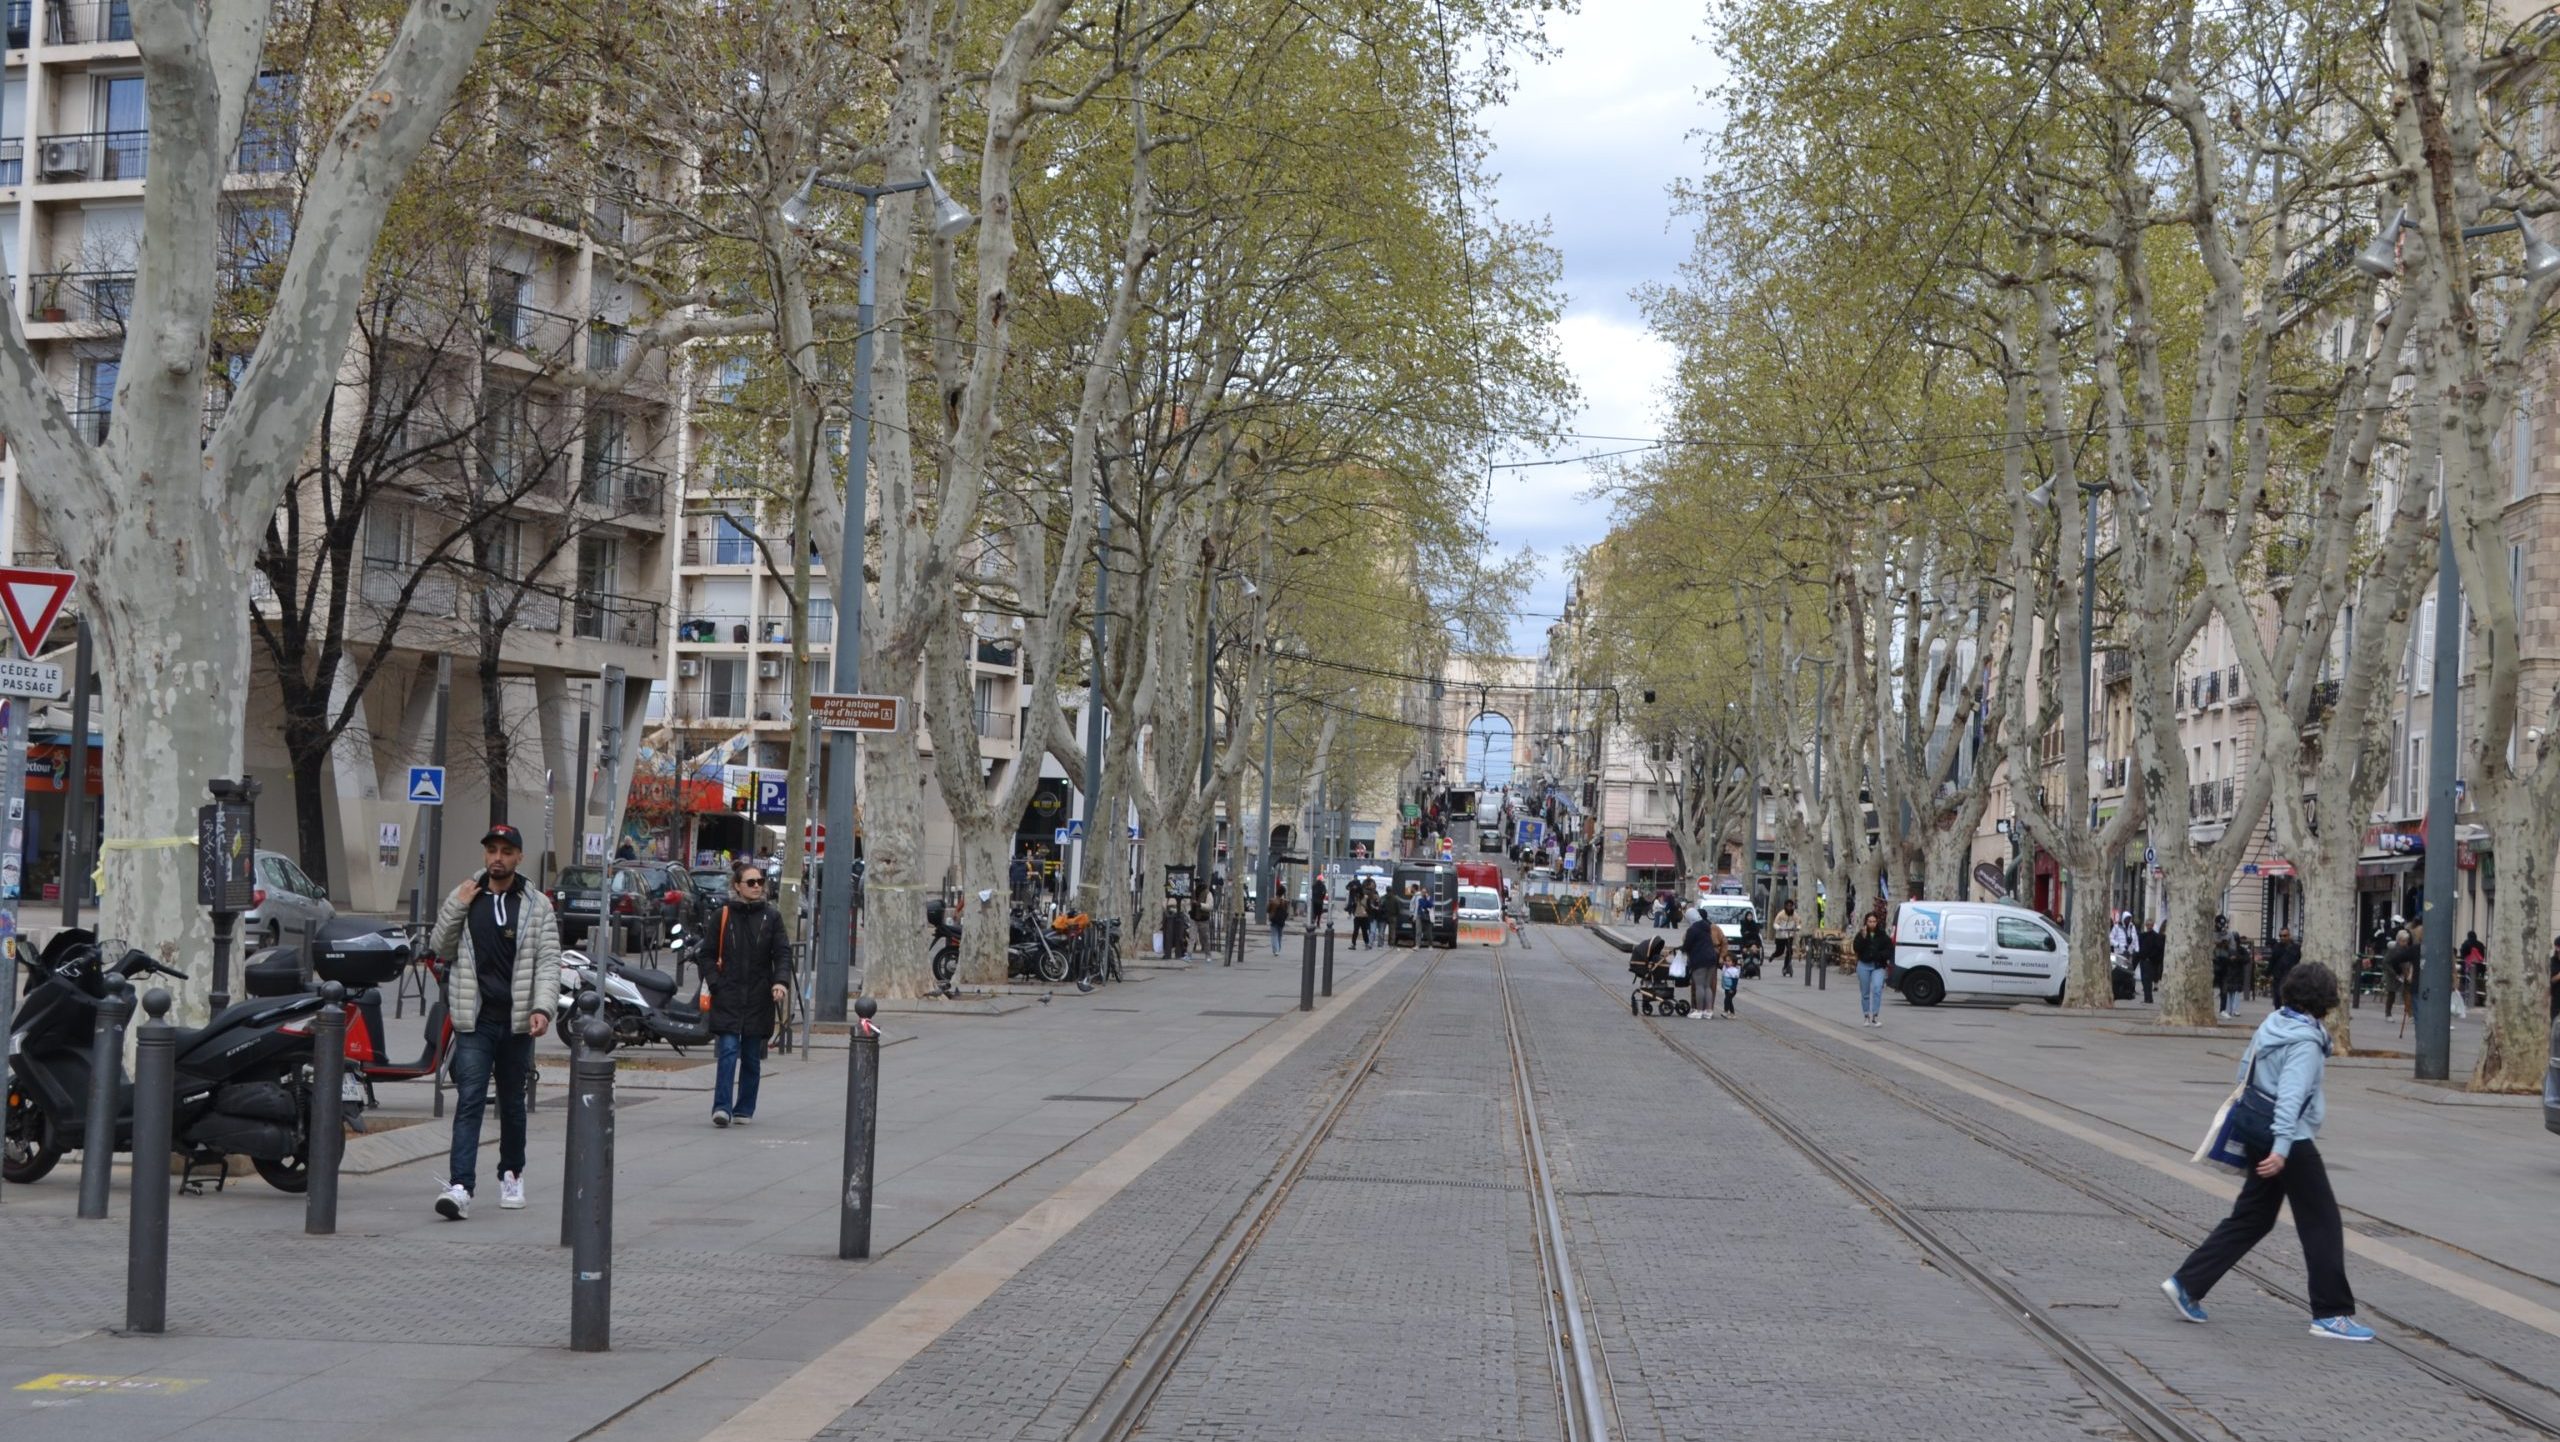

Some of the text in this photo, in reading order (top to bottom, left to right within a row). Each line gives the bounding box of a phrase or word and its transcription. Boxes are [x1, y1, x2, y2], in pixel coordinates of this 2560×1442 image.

[0, 663, 57, 680] CÉDEZ LE
[3, 679, 53, 693] PASSAGE
[824, 699, 880, 710] port antique
[810, 708, 879, 718] usée d'histoire
[25, 761, 51, 773] ectour
[761, 782, 779, 805] P
